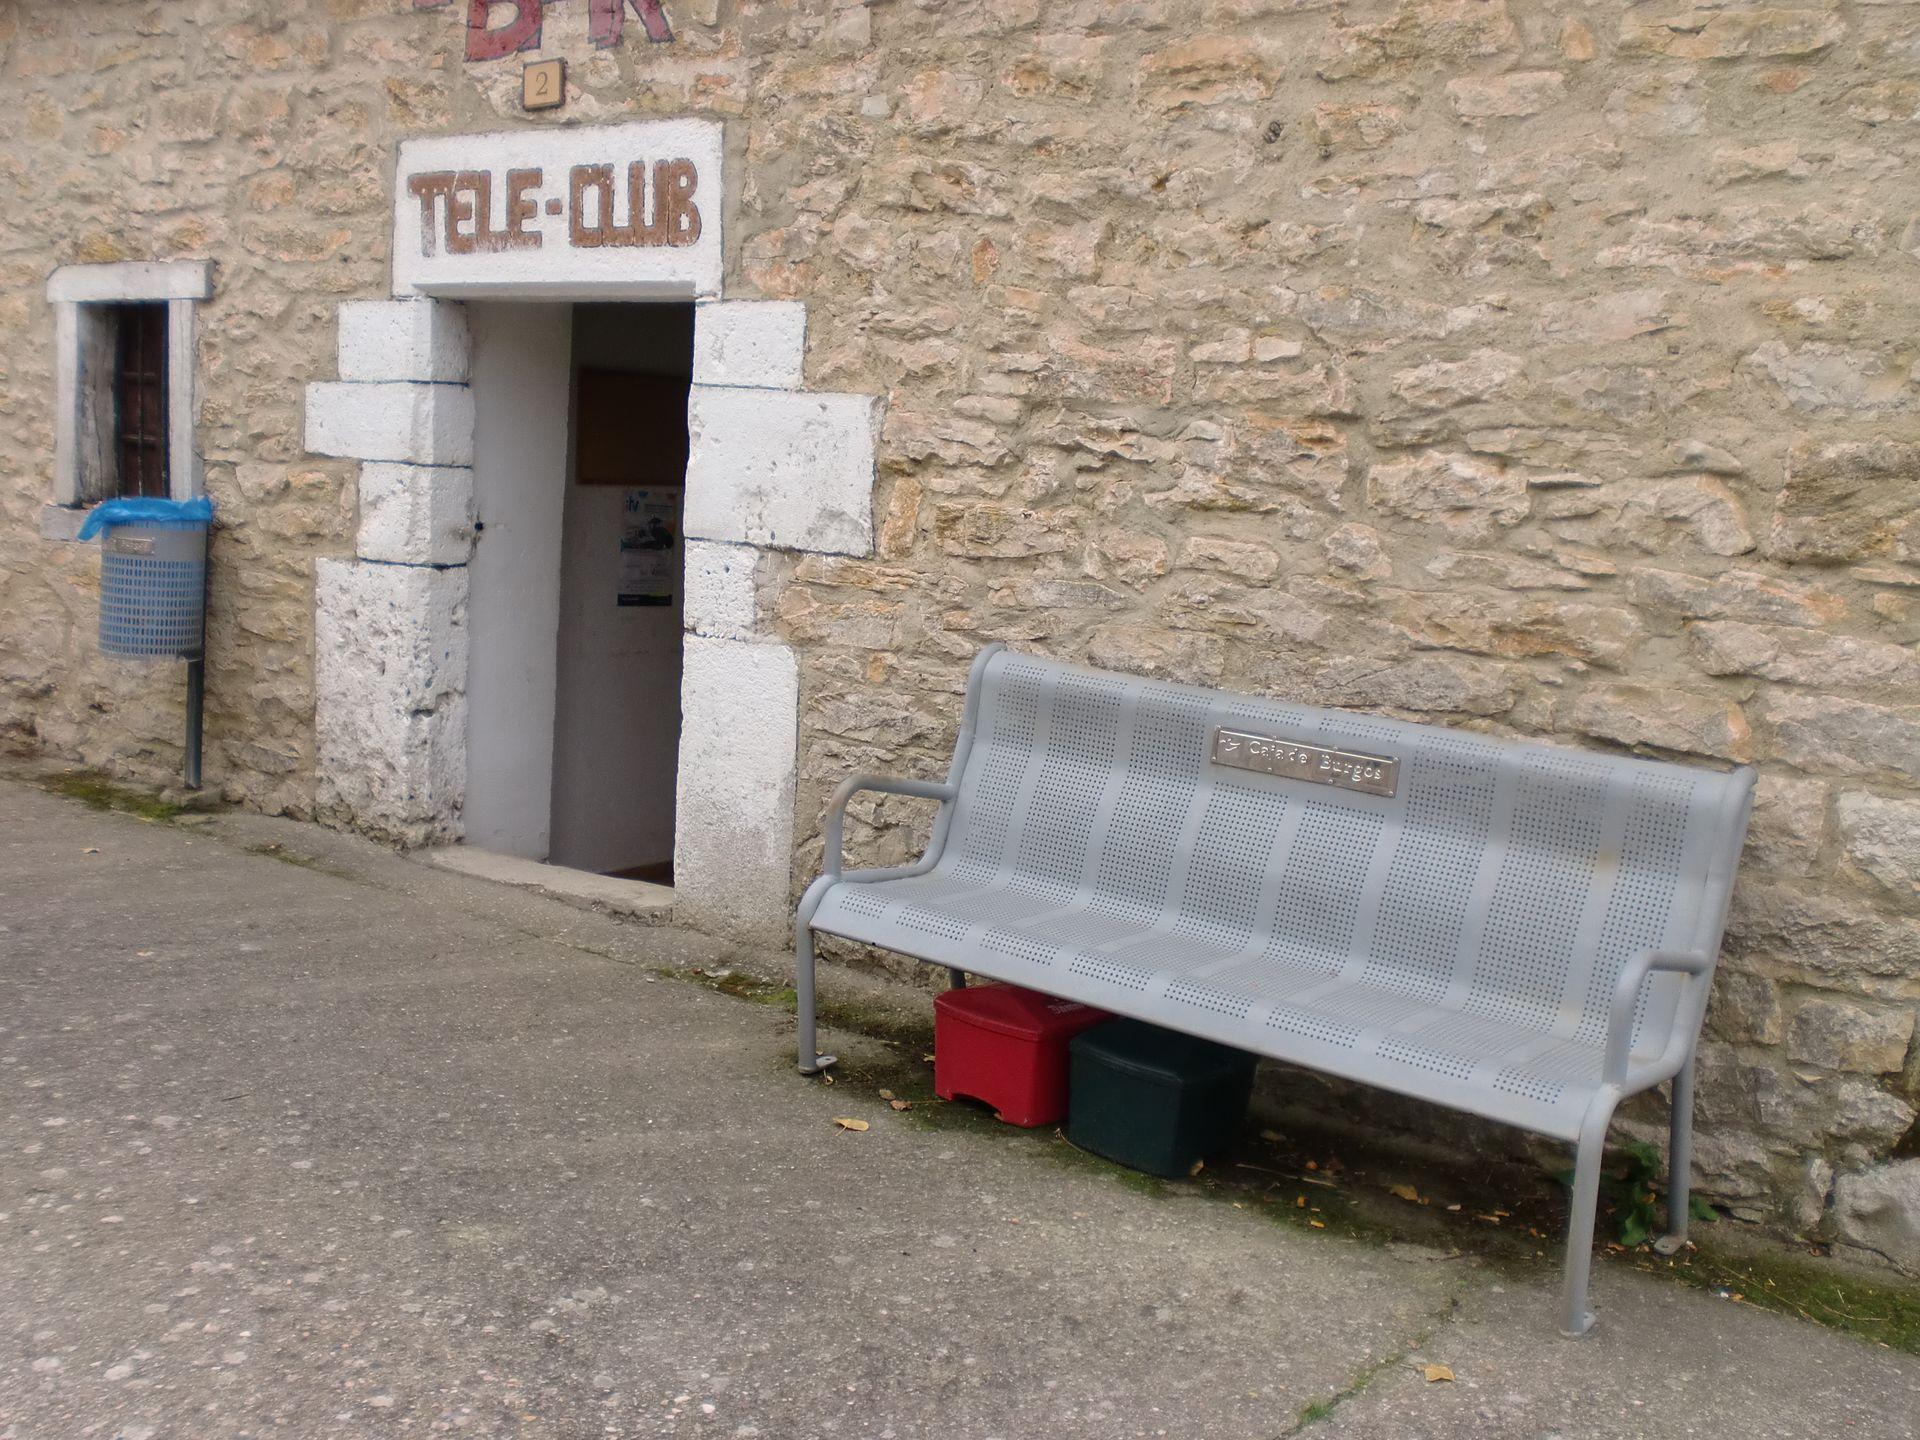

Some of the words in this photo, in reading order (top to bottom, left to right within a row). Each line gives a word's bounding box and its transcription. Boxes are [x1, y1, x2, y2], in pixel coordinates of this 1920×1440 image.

[535, 71, 549, 96] 2
[407, 158, 702, 258] TELE-CLUB
[1320, 754, 1382, 782] Burgos
